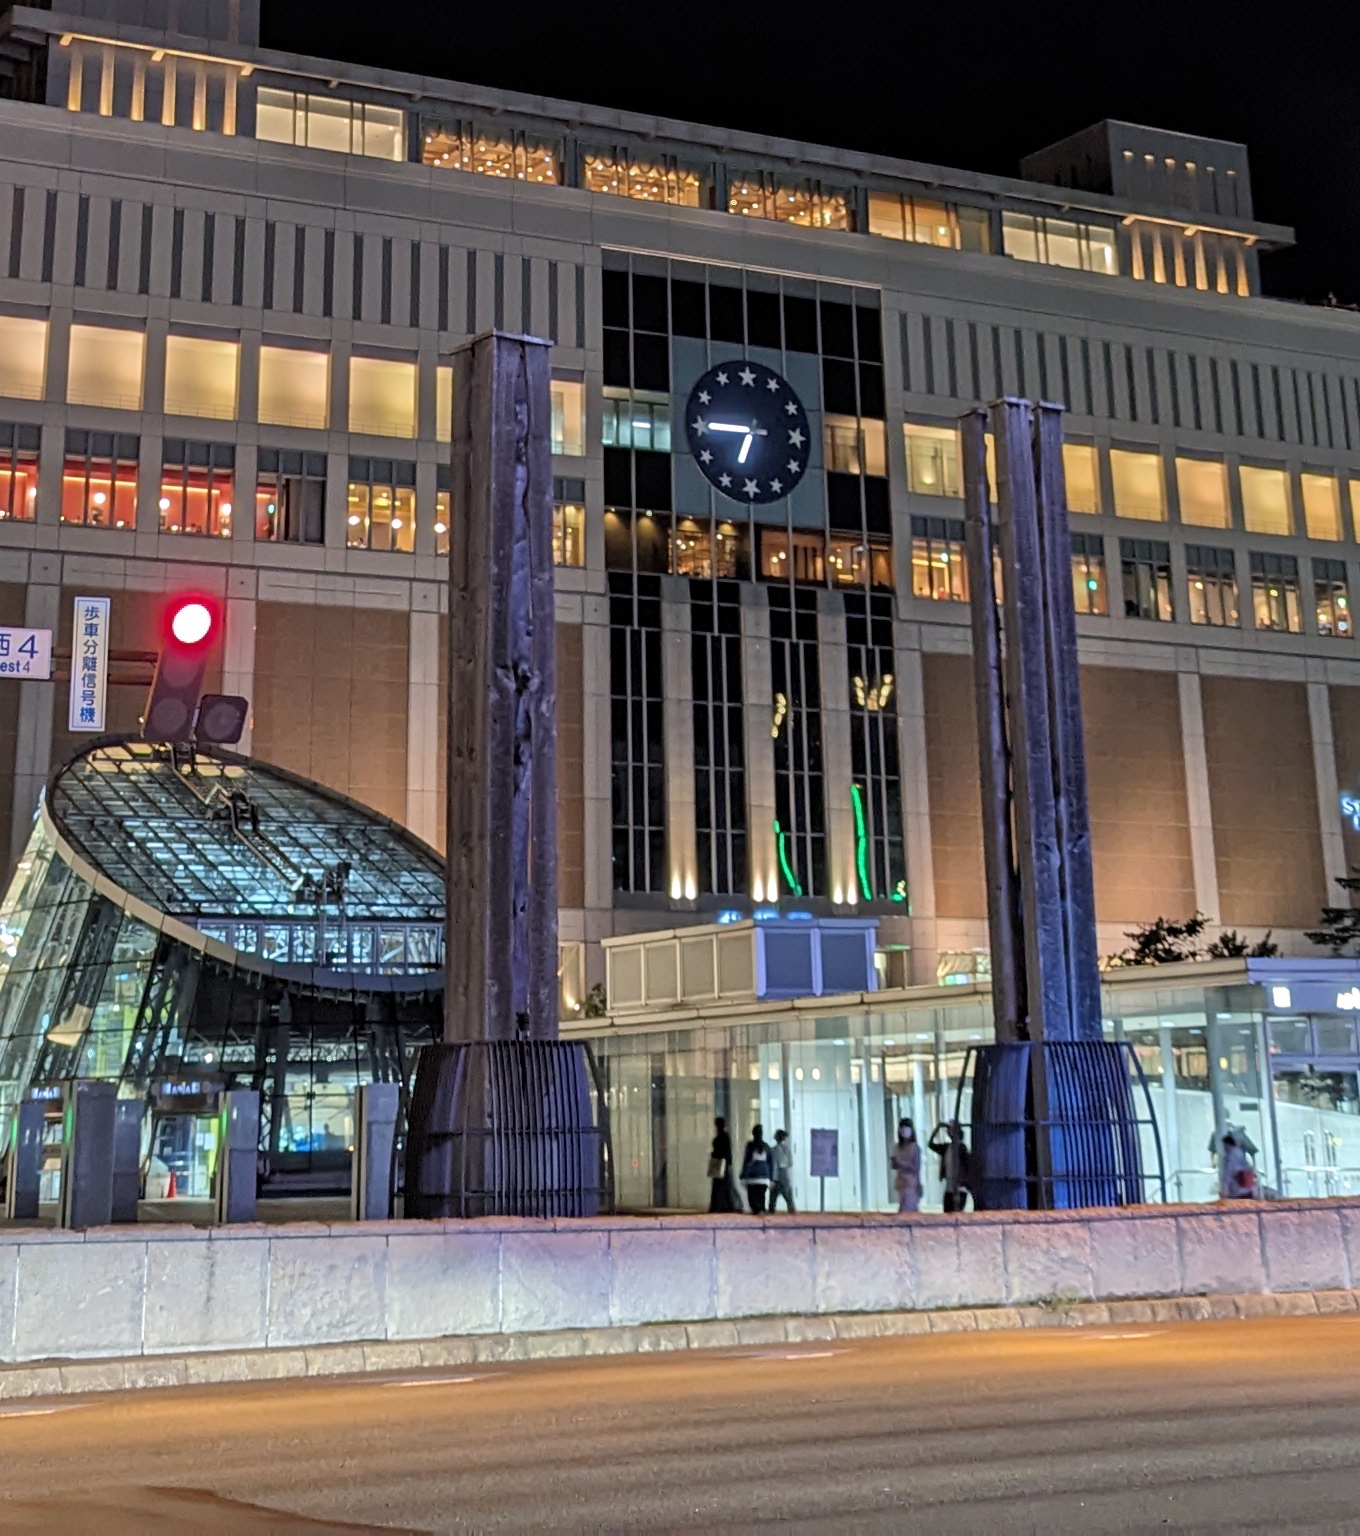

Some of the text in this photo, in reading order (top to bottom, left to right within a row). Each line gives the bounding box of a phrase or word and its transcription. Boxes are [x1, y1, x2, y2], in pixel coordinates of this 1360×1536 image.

[79, 605, 100, 724] 歩車分離信号機
